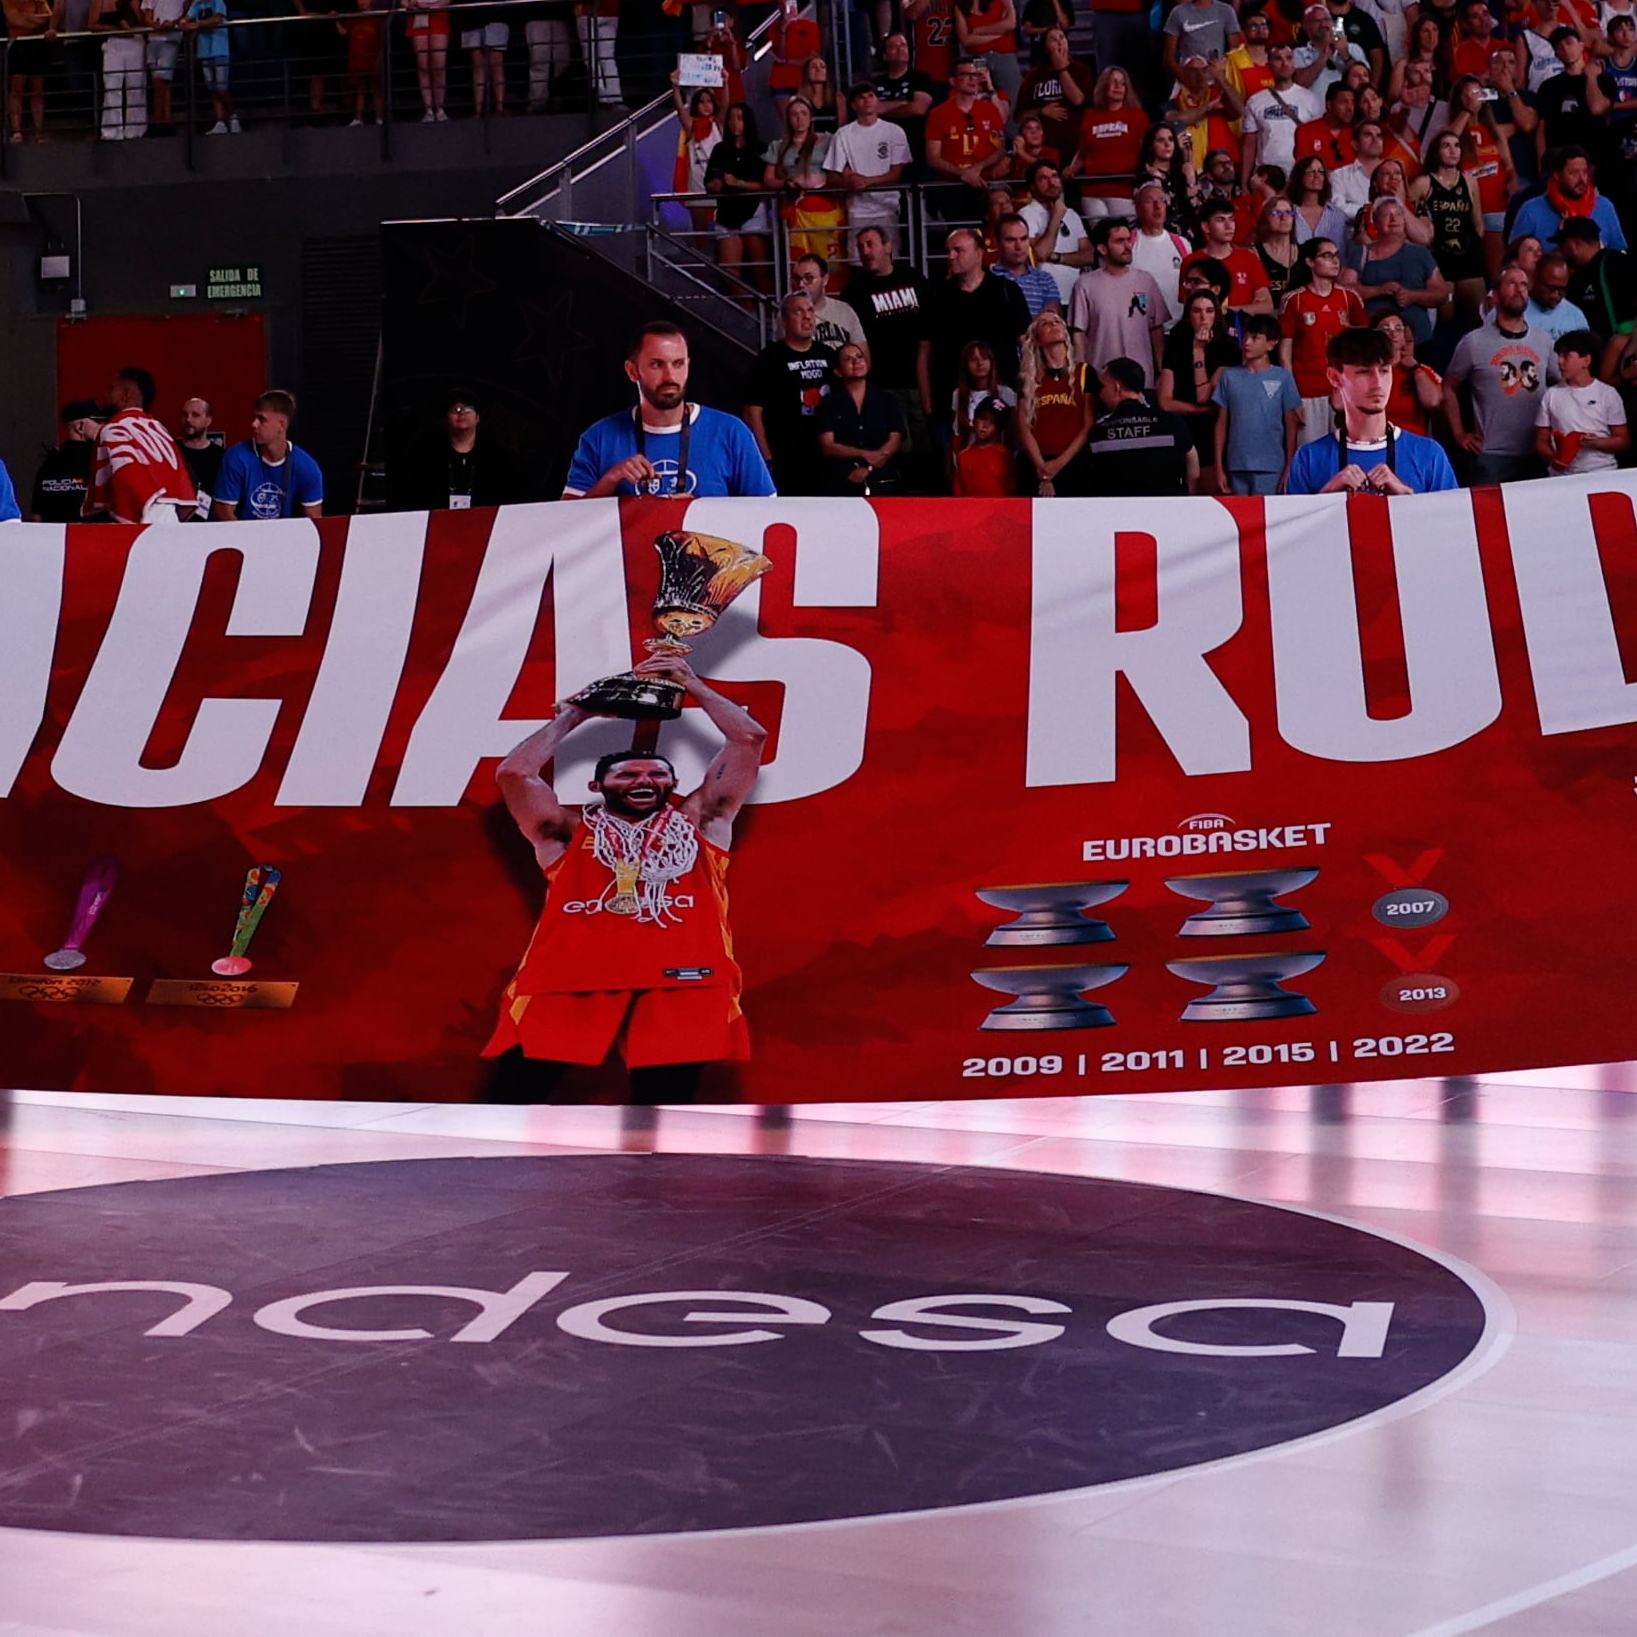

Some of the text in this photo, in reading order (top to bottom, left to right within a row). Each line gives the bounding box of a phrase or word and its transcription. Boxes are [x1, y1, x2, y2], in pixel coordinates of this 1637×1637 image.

[209, 267, 259, 283] SALIDA DE
[207, 283, 262, 299] EMERGENCIA
[871, 286, 920, 313] MIAMI
[787, 358, 829, 371] INFLATION
[1107, 425, 1151, 440] STAFF
[1189, 818, 1224, 830] FIBA
[1082, 822, 1331, 861] EUROBASKET
[1386, 900, 1436, 916] 2007
[1399, 986, 1447, 1002] 2013
[962, 1055, 1063, 1078] 2009
[1101, 1049, 1184, 1072] 2011
[1223, 1042, 1315, 1066] 2015
[1353, 1032, 1455, 1058] 2022
